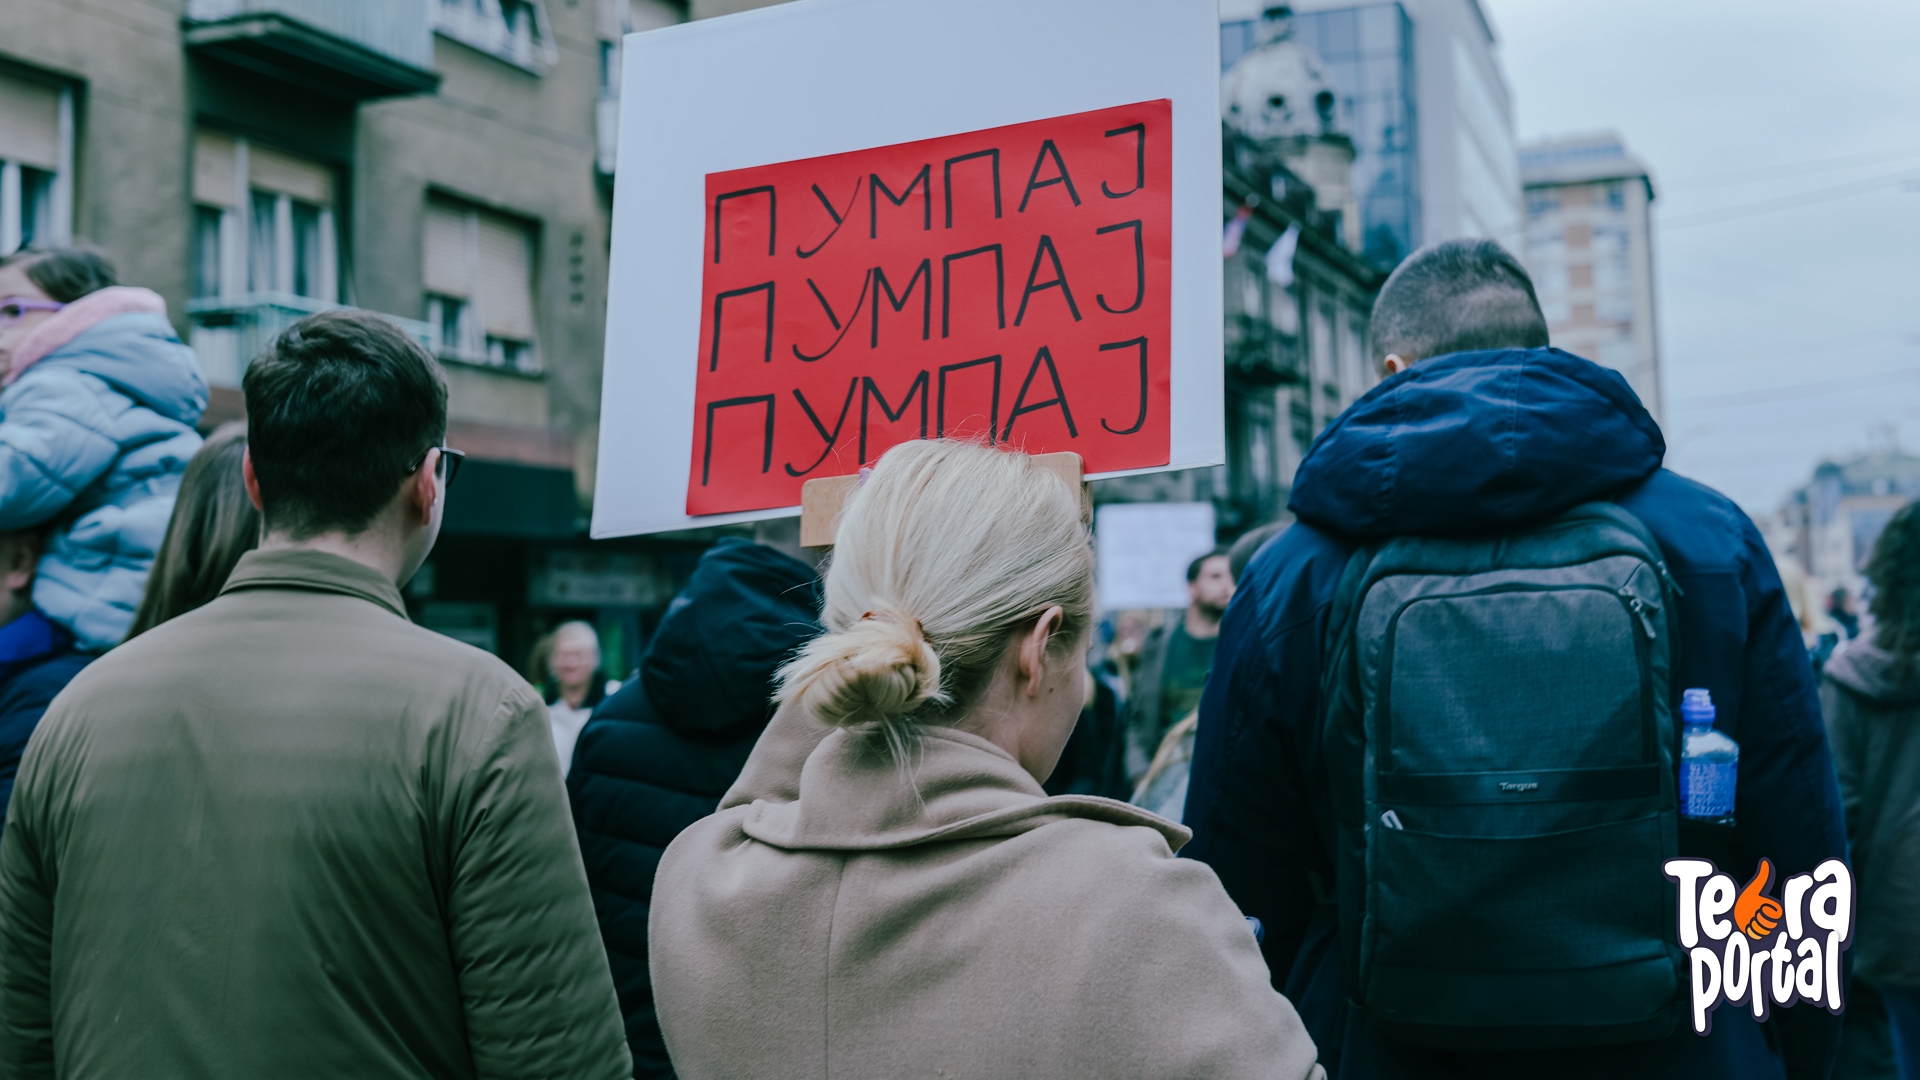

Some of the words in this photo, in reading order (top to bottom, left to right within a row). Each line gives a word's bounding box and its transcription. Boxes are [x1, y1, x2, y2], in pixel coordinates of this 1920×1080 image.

[714, 122, 1145, 263] ПУМПАЈ
[709, 219, 1145, 372] ПУМПАЈ
[702, 335, 1149, 487] ПУМПАЈ
[1499, 781, 1538, 792] Targus
